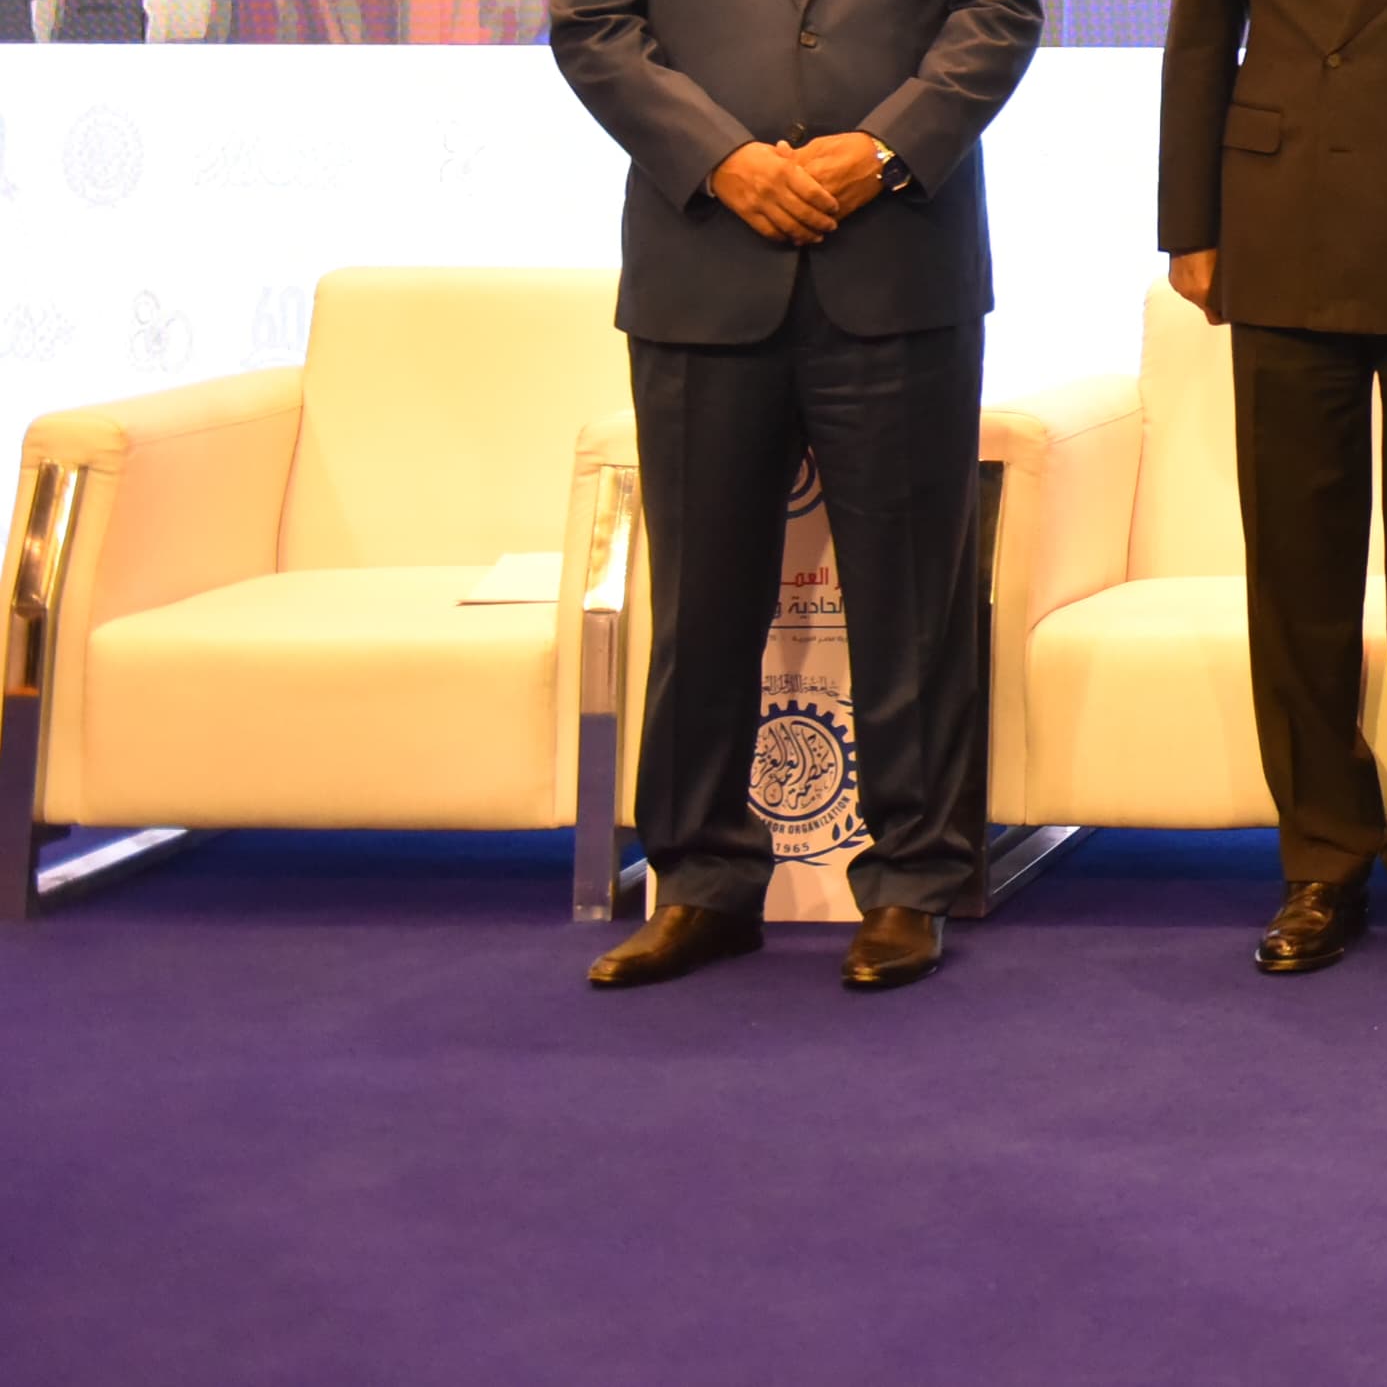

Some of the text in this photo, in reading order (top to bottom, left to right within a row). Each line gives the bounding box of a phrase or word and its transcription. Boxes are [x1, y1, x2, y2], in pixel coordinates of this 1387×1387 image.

[780, 567, 829, 588] العم
[788, 595, 844, 620] لحادية
[775, 842, 810, 853] 1965
